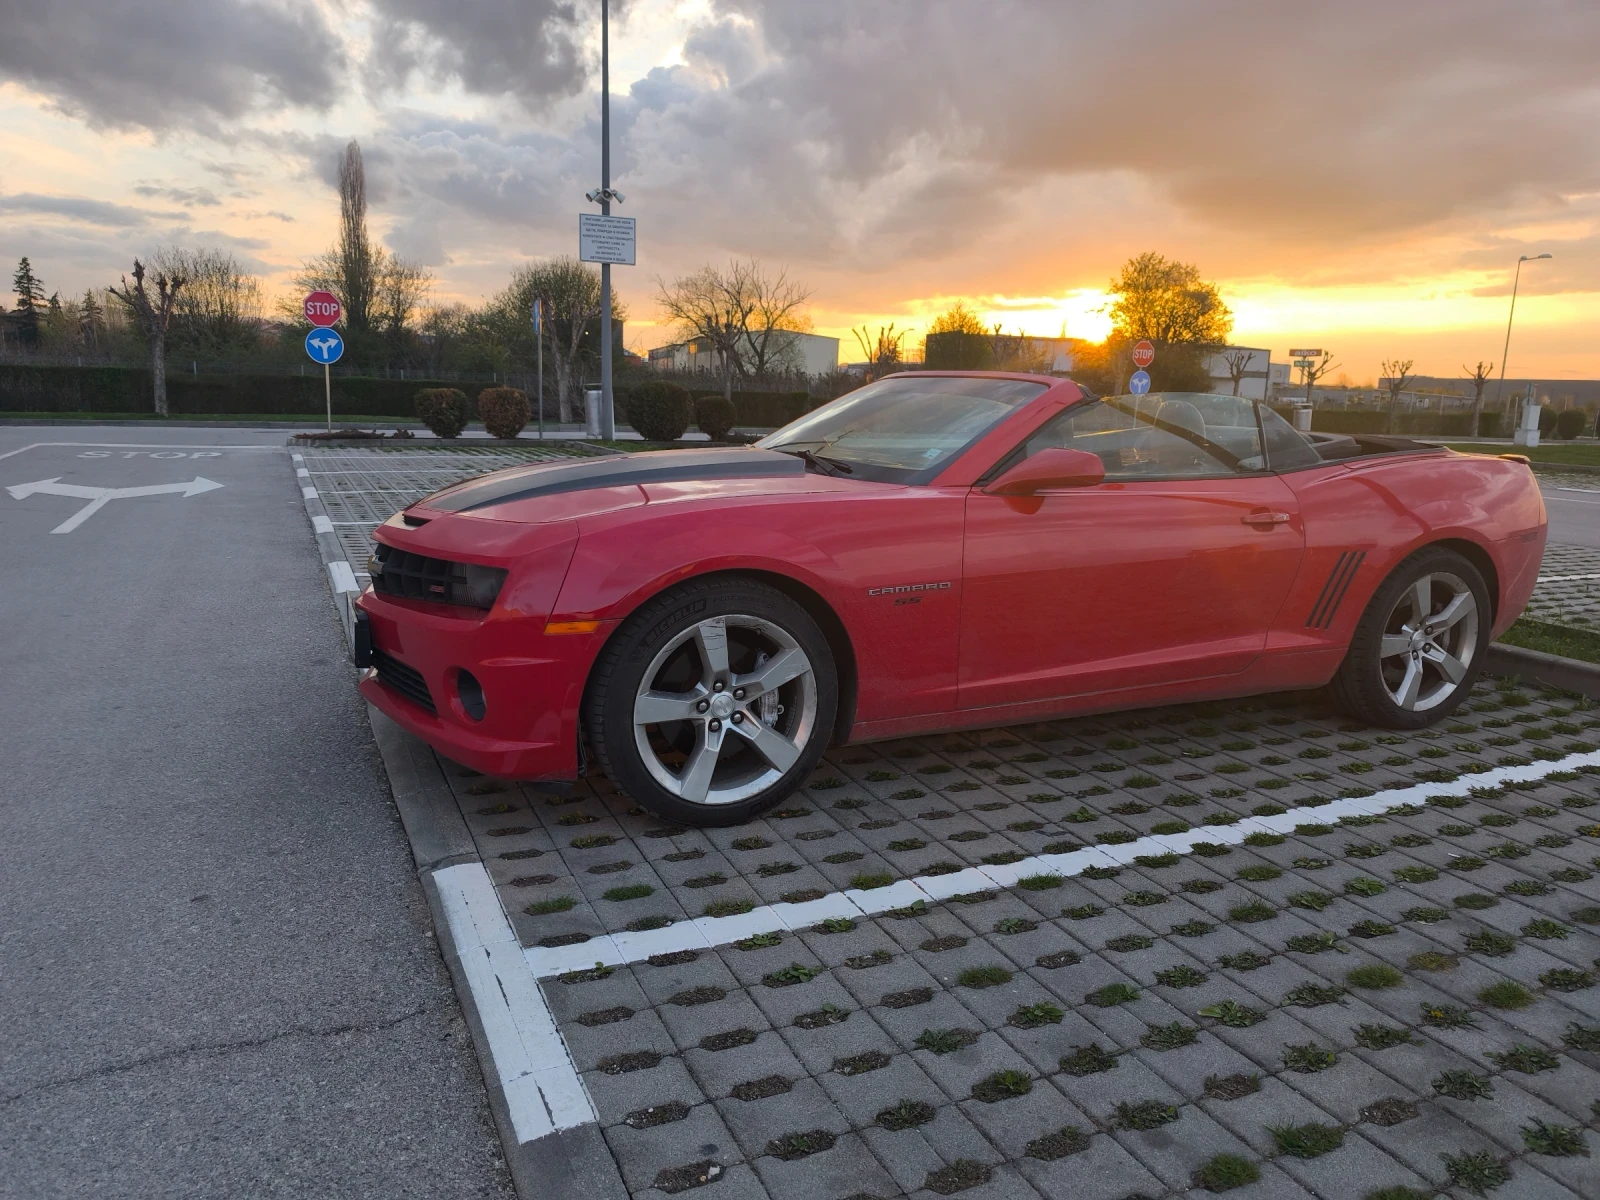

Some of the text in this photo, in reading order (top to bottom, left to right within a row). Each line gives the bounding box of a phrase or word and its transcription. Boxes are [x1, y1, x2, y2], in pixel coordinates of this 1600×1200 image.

[307, 302, 338, 316] STOP
[1134, 349, 1153, 359] STOP
[76, 451, 222, 459] STOP
[868, 582, 951, 596] CAMARO
[894, 596, 922, 605] SS
[645, 601, 704, 646] MICHELIN
